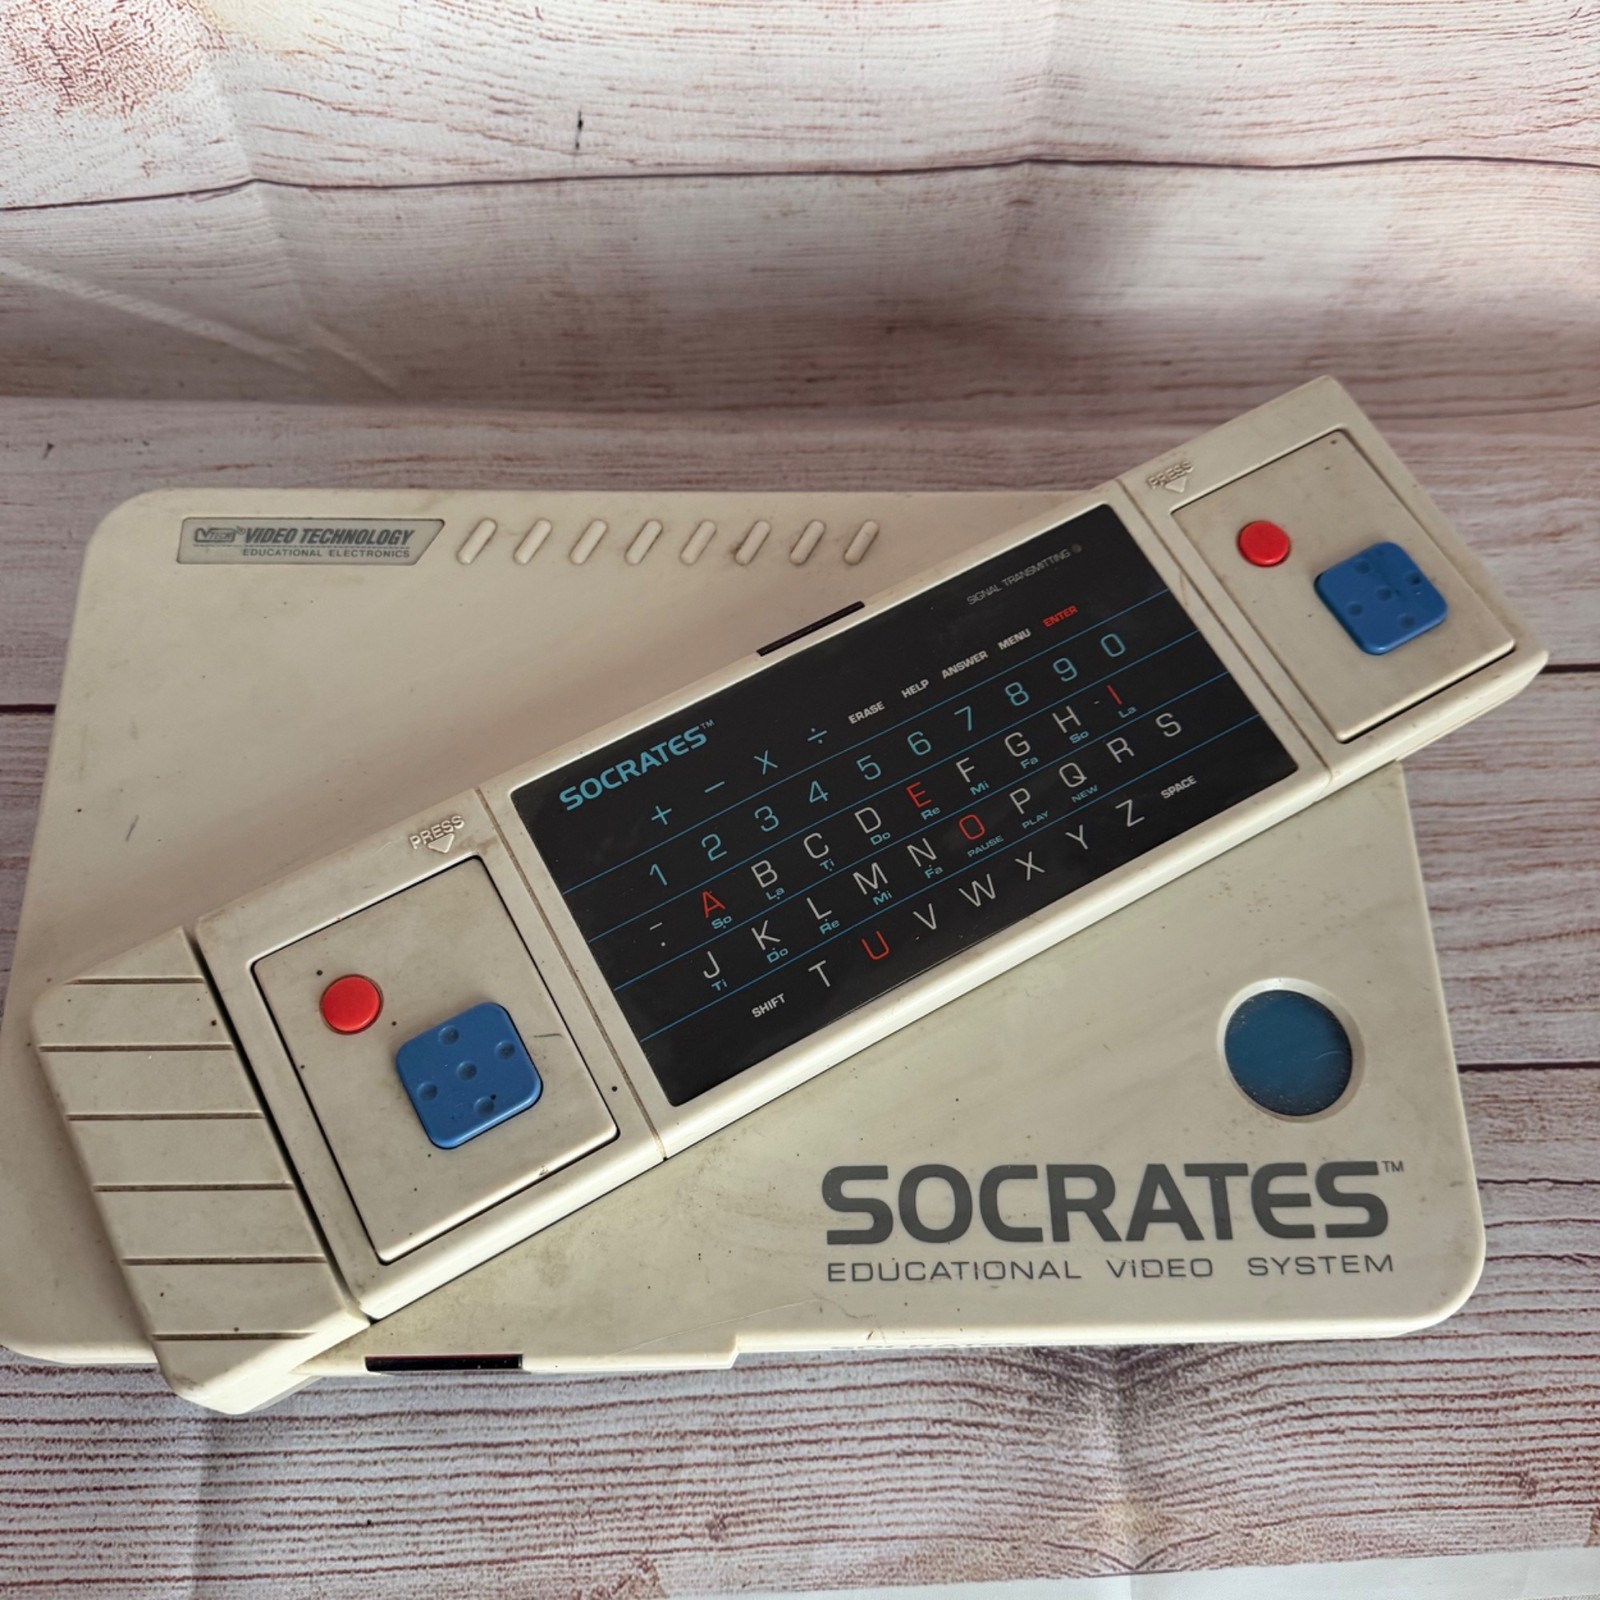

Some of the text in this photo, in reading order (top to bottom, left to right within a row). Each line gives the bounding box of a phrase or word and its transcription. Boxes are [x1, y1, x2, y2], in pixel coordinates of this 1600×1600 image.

[1145, 461, 1194, 490] PRESS
[243, 548, 410, 559] EDUCATIONAL ELECTRONICS
[245, 527, 298, 544] VIDEO
[299, 529, 415, 546] TECHNOLOGY
[966, 548, 1071, 606] SIGNAL TRANSMITTING
[848, 701, 884, 724] ERASE
[902, 680, 929, 698] HELP
[942, 650, 988, 678] ANSWER
[998, 628, 1030, 650] MENU
[1044, 606, 1077, 627] ENTER
[650, 633, 1125, 886] 1 2 3 4 5 6 7 8 9 0
[702, 891, 725, 918] A
[751, 860, 778, 888] B
[804, 832, 828, 858] C
[854, 807, 882, 834] D
[906, 782, 932, 808] E
[956, 758, 975, 782] F
[1004, 732, 1030, 757] G
[1052, 706, 1081, 733] H
[711, 705, 1136, 930] So La Ti Do Re Mi Fa So La
[409, 815, 465, 850] PRESS
[704, 713, 1182, 979] J K L M N O P Q R S
[712, 784, 1098, 992] Ti Do Re Mi Fa PAUSE PLAY NEW
[752, 994, 785, 1018] SHIFT
[808, 960, 830, 988] T
[861, 932, 890, 960] U
[914, 904, 936, 930] V
[959, 873, 996, 907] W
[1066, 825, 1088, 850] Y
[1116, 800, 1144, 827] Z
[1160, 776, 1196, 799] SPACE
[827, 1254, 1394, 1283] EDUCATIONAL VIDEO SYSTEM
